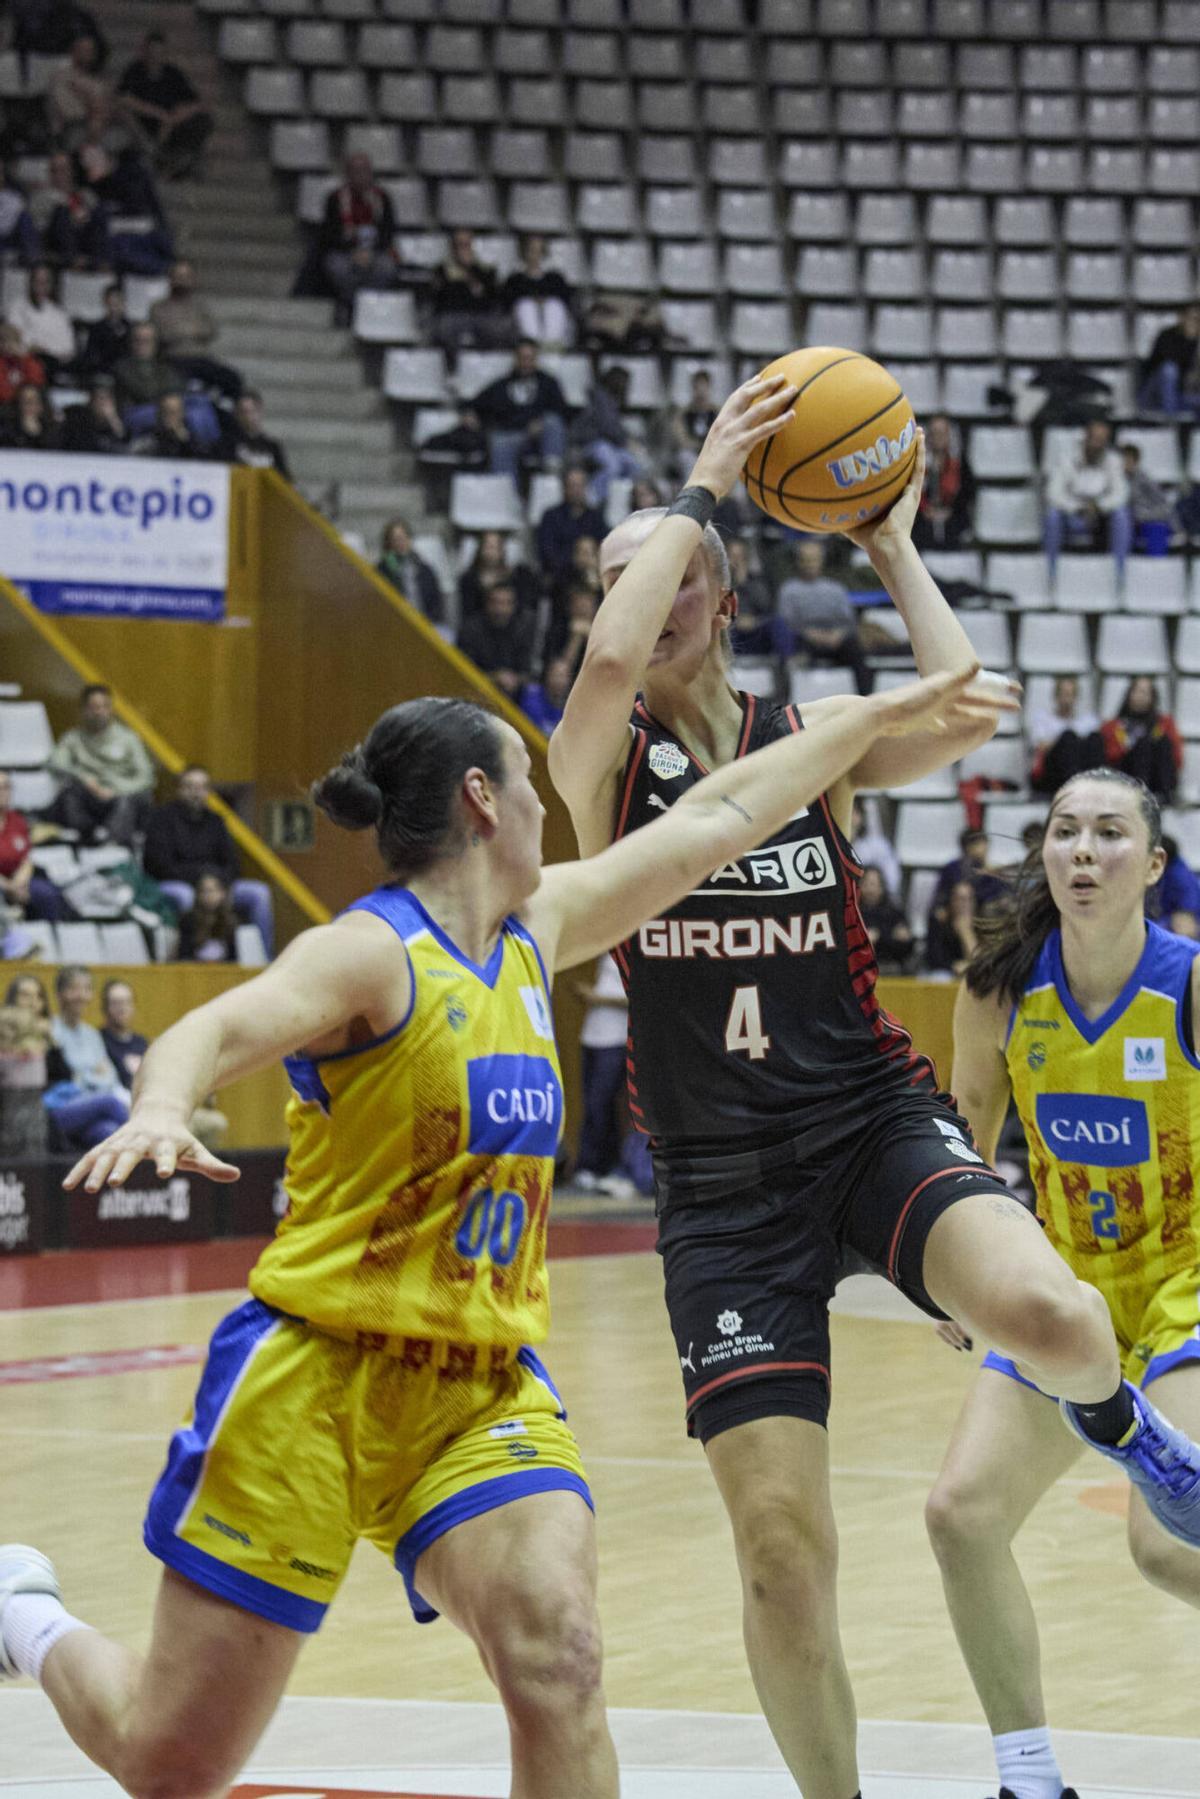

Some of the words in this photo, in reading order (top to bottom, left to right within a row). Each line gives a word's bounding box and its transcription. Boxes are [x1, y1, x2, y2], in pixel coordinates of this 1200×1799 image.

[651, 758, 683, 772] GIRONA
[709, 859, 784, 885] AR
[639, 911, 836, 958] GIRONA
[725, 985, 770, 1060] 4
[486, 1081, 555, 1125] CADÍ
[1050, 1117, 1132, 1146] CADÍ
[455, 1187, 527, 1267] 00
[1088, 1189, 1122, 1239] 2
[701, 1350, 731, 1367] Pirineu
[732, 1346, 744, 1356] de
[745, 1342, 774, 1353] Girona
[708, 1340, 733, 1353] Costa
[735, 1334, 762, 1346] Brava
